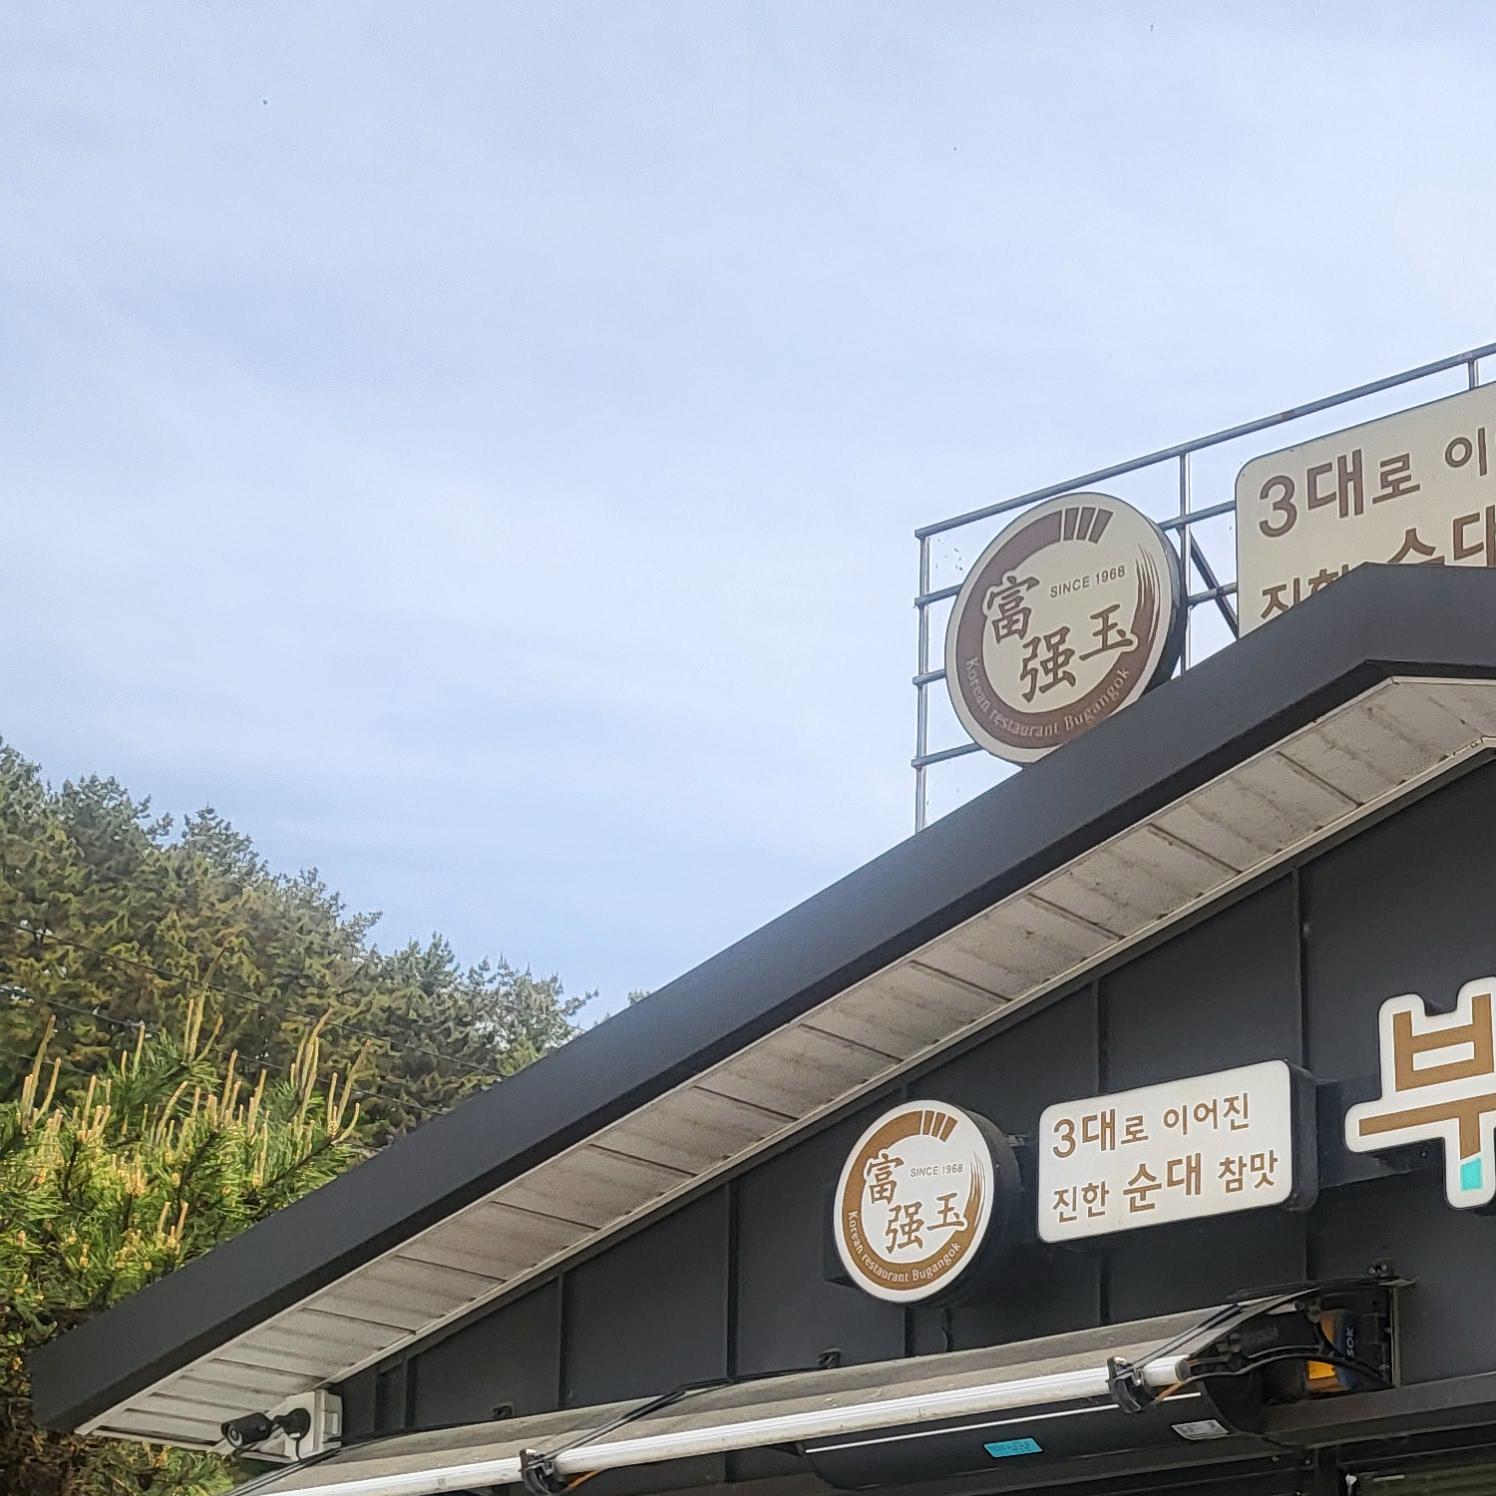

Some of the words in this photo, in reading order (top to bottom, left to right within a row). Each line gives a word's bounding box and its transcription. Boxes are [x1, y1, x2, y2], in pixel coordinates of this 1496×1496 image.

[1258, 447, 1421, 539] 3대로
[1049, 575, 1091, 599] SINCE
[1095, 564, 1126, 586] 1968
[966, 656, 991, 711] Korean
[990, 708, 1059, 738] restaurant
[1062, 667, 1130, 731] Bugangok
[1052, 1108, 1150, 1159] 3대로
[1162, 1092, 1250, 1136] 이어진
[909, 1165, 940, 1178] SINCE
[941, 1163, 964, 1176] 1968
[1052, 1180, 1110, 1224] 진한
[1122, 1152, 1202, 1214] 순대
[1217, 1149, 1279, 1194] 참맛
[847, 1210, 863, 1254] Korean
[861, 1254, 910, 1283] restaurant
[911, 1242, 961, 1282] Bugangok
